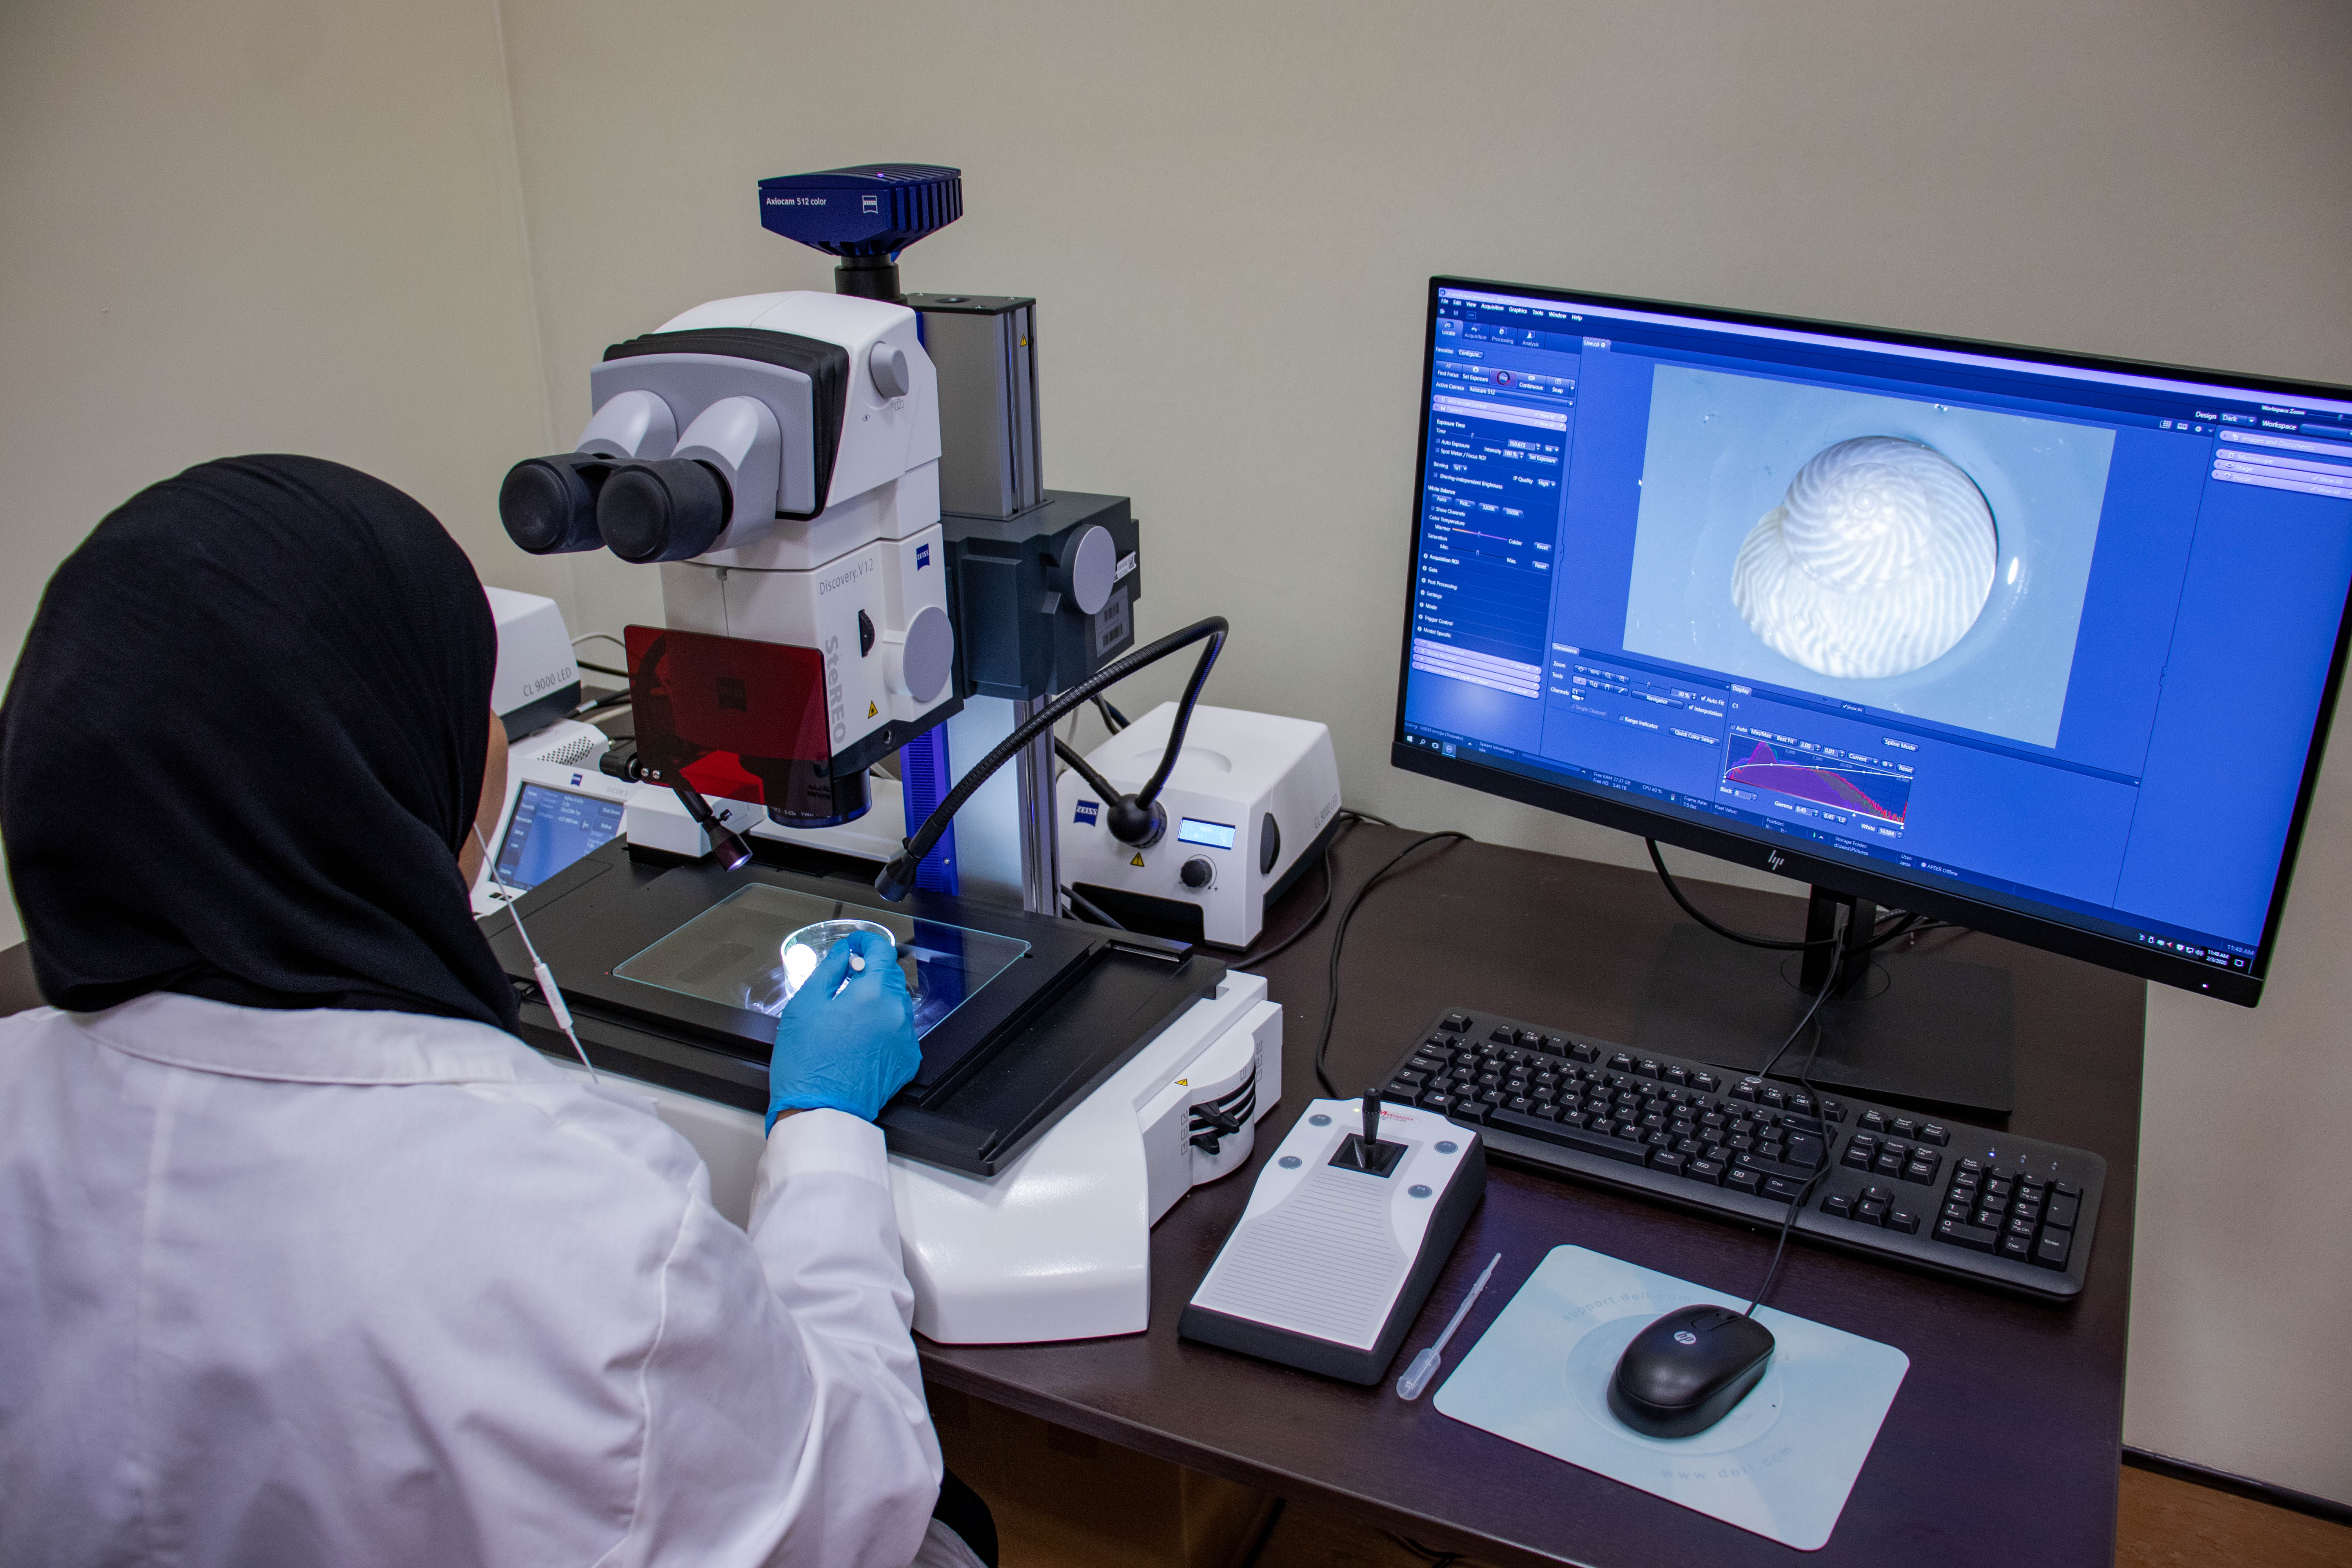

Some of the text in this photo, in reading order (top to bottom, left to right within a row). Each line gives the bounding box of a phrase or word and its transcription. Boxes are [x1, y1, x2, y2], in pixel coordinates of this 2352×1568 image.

[1469, 386, 1486, 394] Axiocam
[1519, 382, 1543, 391] Continuous
[2261, 405, 2288, 414] Workspace
[2196, 411, 2216, 420] Design
[2262, 420, 2296, 430] Workspace
[1485, 446, 1501, 455] Intensity
[1442, 517, 1465, 526] Temperature
[917, 550, 929, 560] ZEISS
[1430, 555, 1449, 563] Acquisition
[820, 558, 874, 595] Discovery.V12
[1426, 591, 1442, 599] Settings
[1553, 644, 1577, 654] Dimensions
[523, 667, 571, 697] CL 9000 LED
[825, 635, 846, 744] SteREO
[1550, 686, 1569, 696] Channels
[1733, 685, 1749, 694] Display
[1647, 695, 1668, 705] Navigator
[1694, 706, 1722, 717] Interpolation
[1624, 717, 1658, 729] Range Indicator
[1751, 728, 1771, 739] Min/Max
[1885, 739, 1915, 751] Spline Mode
[1849, 753, 1867, 762] Current
[1775, 800, 1792, 809] Gamma
[1076, 806, 1097, 816] ZEISS
[1835, 836, 1867, 848] Storage Folder:
[1834, 842, 1868, 856] d:\zeiss\Pictures
[2227, 944, 2254, 956] 11:48 AM
[1563, 1292, 1690, 1321] support.dell.com
